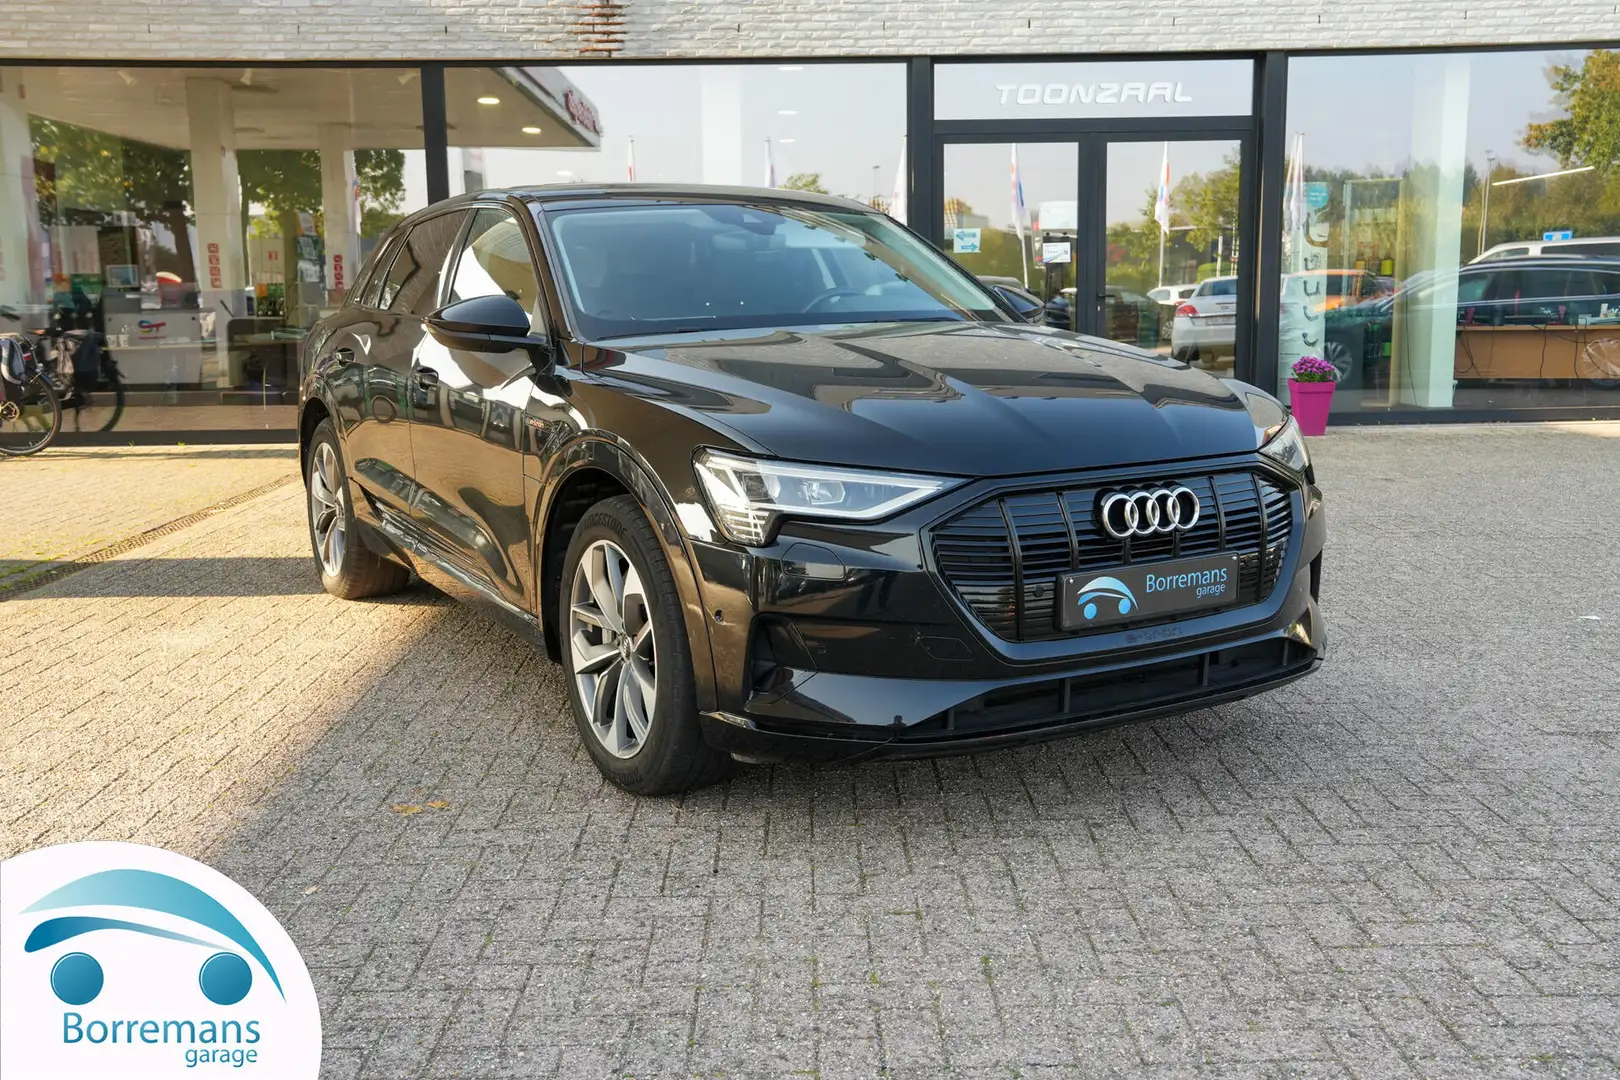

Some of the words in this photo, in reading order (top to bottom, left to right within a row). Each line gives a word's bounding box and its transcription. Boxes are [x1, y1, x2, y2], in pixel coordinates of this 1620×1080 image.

[994, 81, 1193, 105] TOONZAAL
[1146, 568, 1227, 594] Borremans
[1196, 583, 1226, 599] garage
